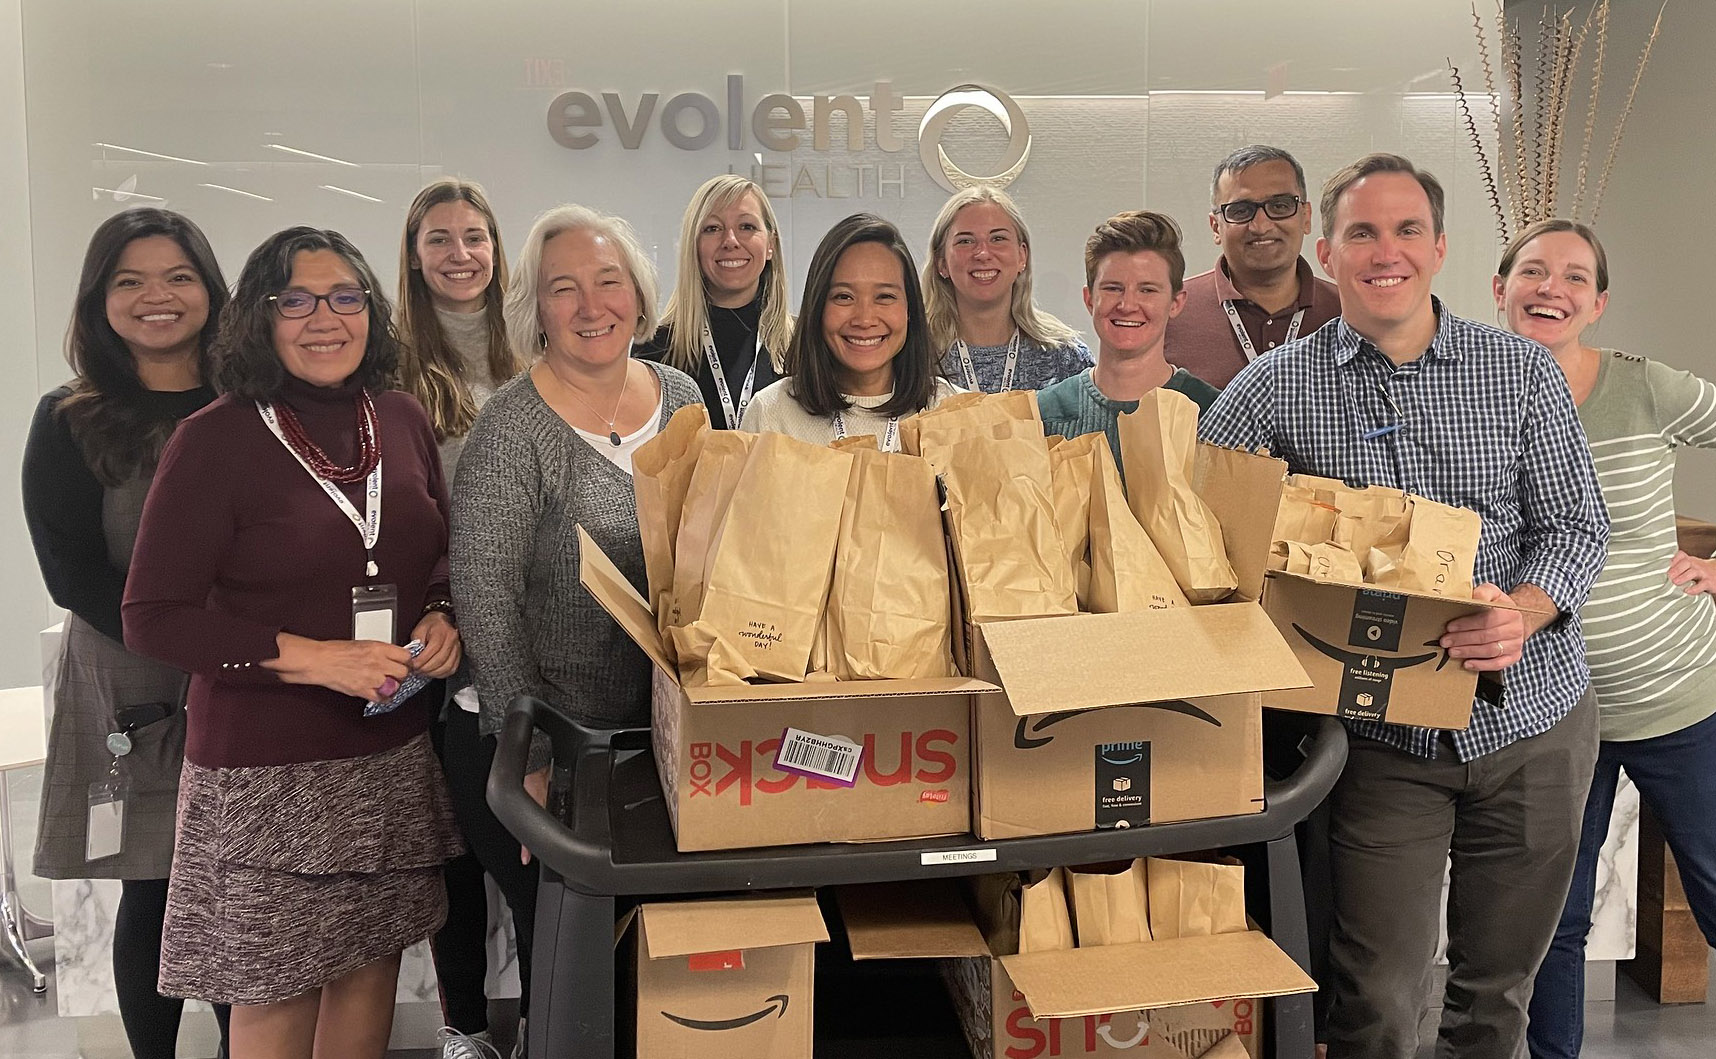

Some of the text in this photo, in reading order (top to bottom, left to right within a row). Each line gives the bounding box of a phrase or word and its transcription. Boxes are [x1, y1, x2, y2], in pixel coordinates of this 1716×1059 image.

[547, 75, 904, 151] evolent
[885, 422, 894, 446] evolent
[368, 509, 378, 536] evolent
[748, 621, 766, 629] HAVE
[738, 630, 783, 642] wonderful
[754, 641, 772, 650] DAY!
[1350, 668, 1362, 676] free
[1362, 669, 1389, 680] listening
[689, 742, 712, 798] BOX
[1102, 795, 1143, 804] free delivery
[942, 852, 978, 861] MEETINGS
[1233, 999, 1253, 1035] BO
